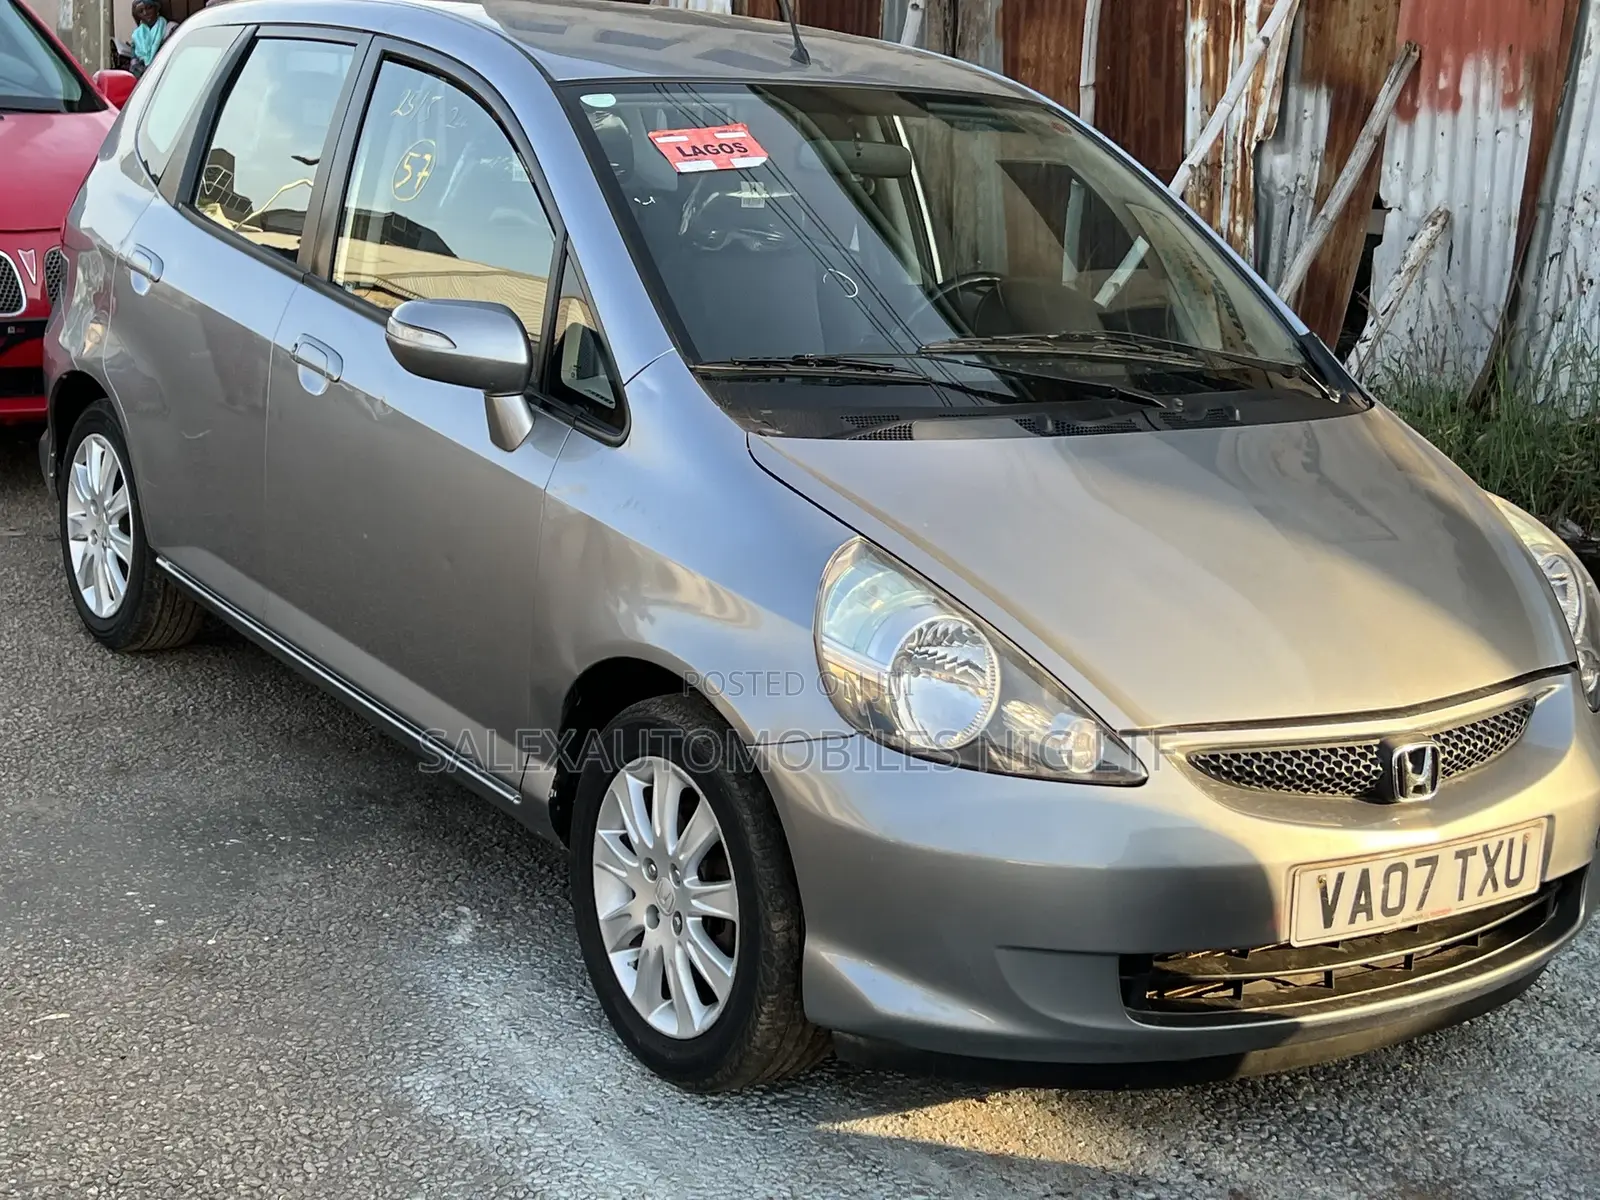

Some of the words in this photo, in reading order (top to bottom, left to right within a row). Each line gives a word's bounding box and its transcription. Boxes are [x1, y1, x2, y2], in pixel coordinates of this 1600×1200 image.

[676, 142, 748, 157] LAGOS
[395, 152, 432, 191] 57
[1319, 855, 1439, 930] VA07
[1454, 836, 1529, 902] TXU
